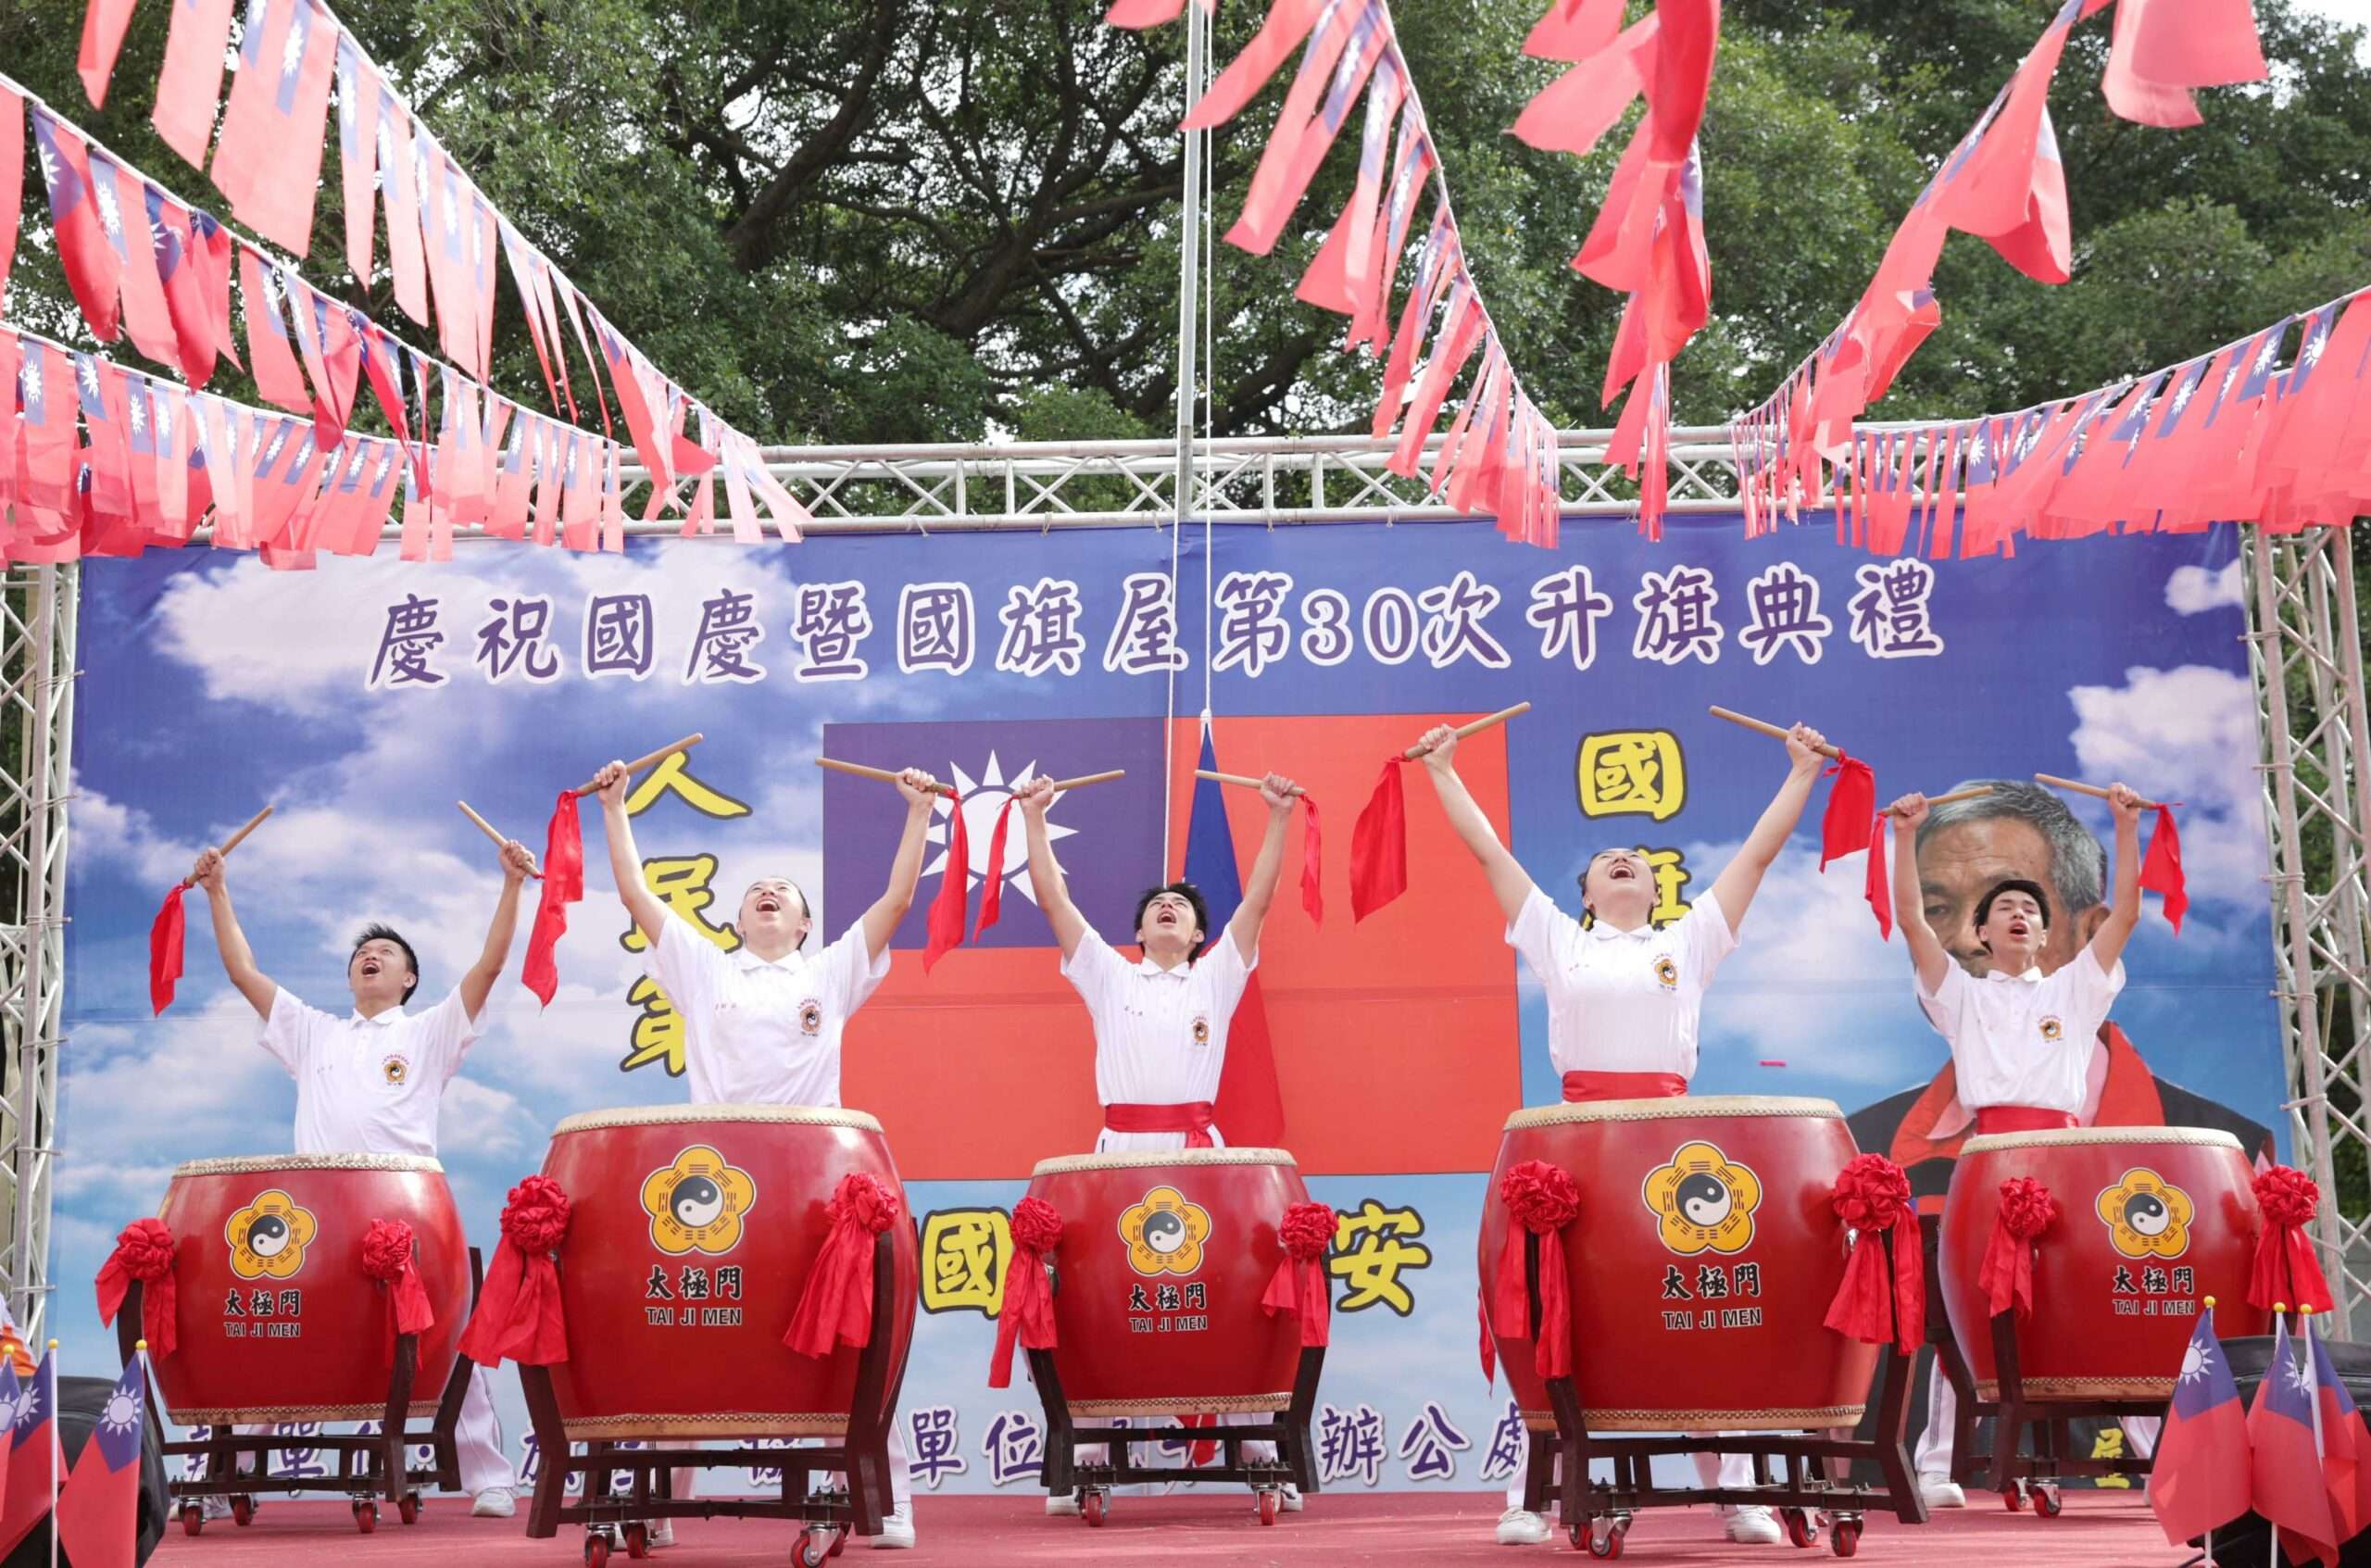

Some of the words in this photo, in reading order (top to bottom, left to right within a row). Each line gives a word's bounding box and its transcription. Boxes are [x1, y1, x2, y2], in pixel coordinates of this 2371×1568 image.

[646, 1264, 742, 1299] 太極門
[1662, 1262, 1761, 1300] 太極門
[2113, 1265, 2194, 1294] 太極門
[224, 1288, 301, 1317] 太極門
[1129, 1282, 1207, 1311] 太極門
[2113, 1298, 2139, 1315] TAI
[2144, 1299, 2158, 1315] JI
[2163, 1299, 2195, 1315] MEN
[224, 1322, 245, 1337] TAI
[251, 1323, 263, 1337] JI
[268, 1323, 301, 1337] MEN
[646, 1307, 673, 1325] TAI
[680, 1307, 696, 1325] JI
[702, 1307, 742, 1326] MEN
[1129, 1317, 1153, 1332] TAI
[1158, 1317, 1171, 1332] JI
[1175, 1315, 1208, 1331] MEN
[1662, 1311, 1693, 1330] TAI
[1700, 1310, 1715, 1329] JI
[1722, 1307, 1762, 1328] MEN
